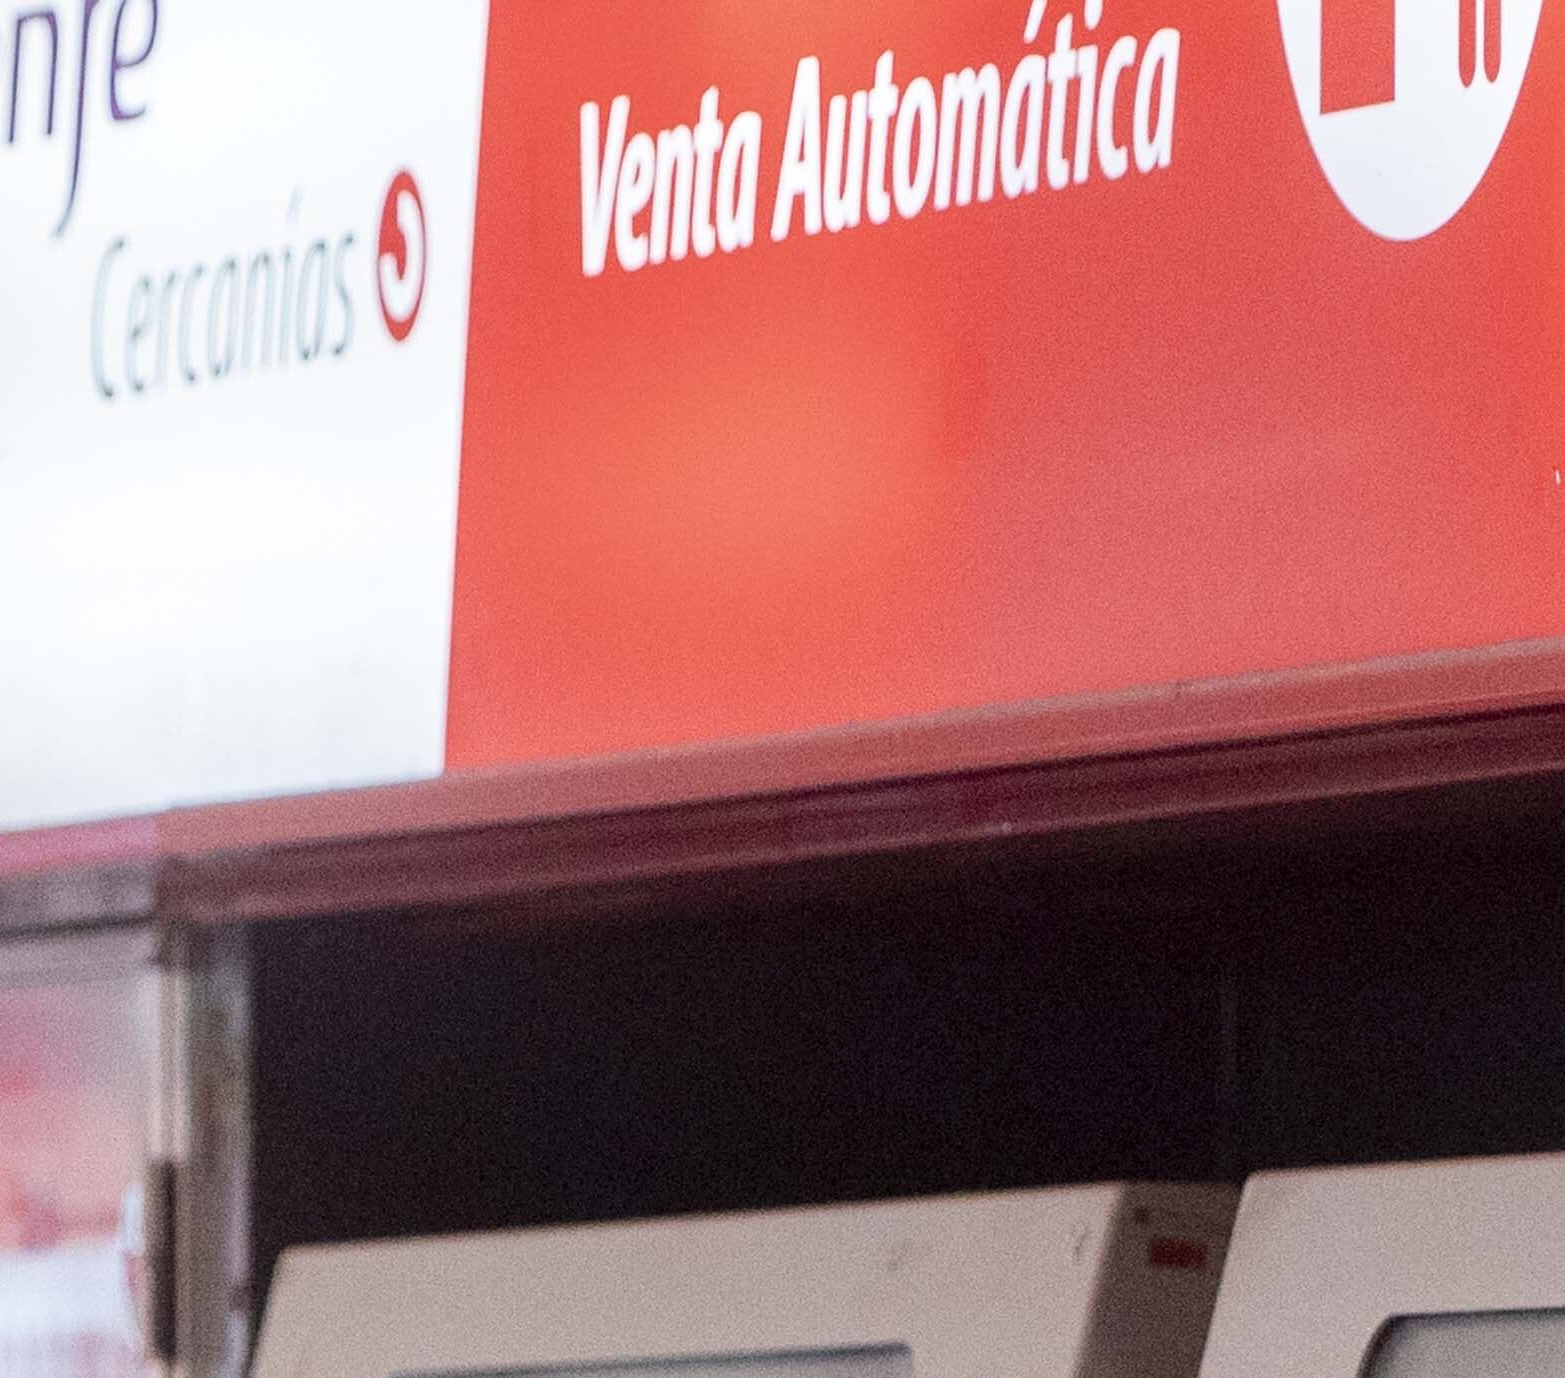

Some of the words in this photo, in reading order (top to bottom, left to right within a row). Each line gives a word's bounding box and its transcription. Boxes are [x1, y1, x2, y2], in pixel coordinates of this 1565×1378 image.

[580, 92, 763, 278] Venta
[771, 0, 1181, 243] Automática
[91, 188, 356, 400] Cercanías
